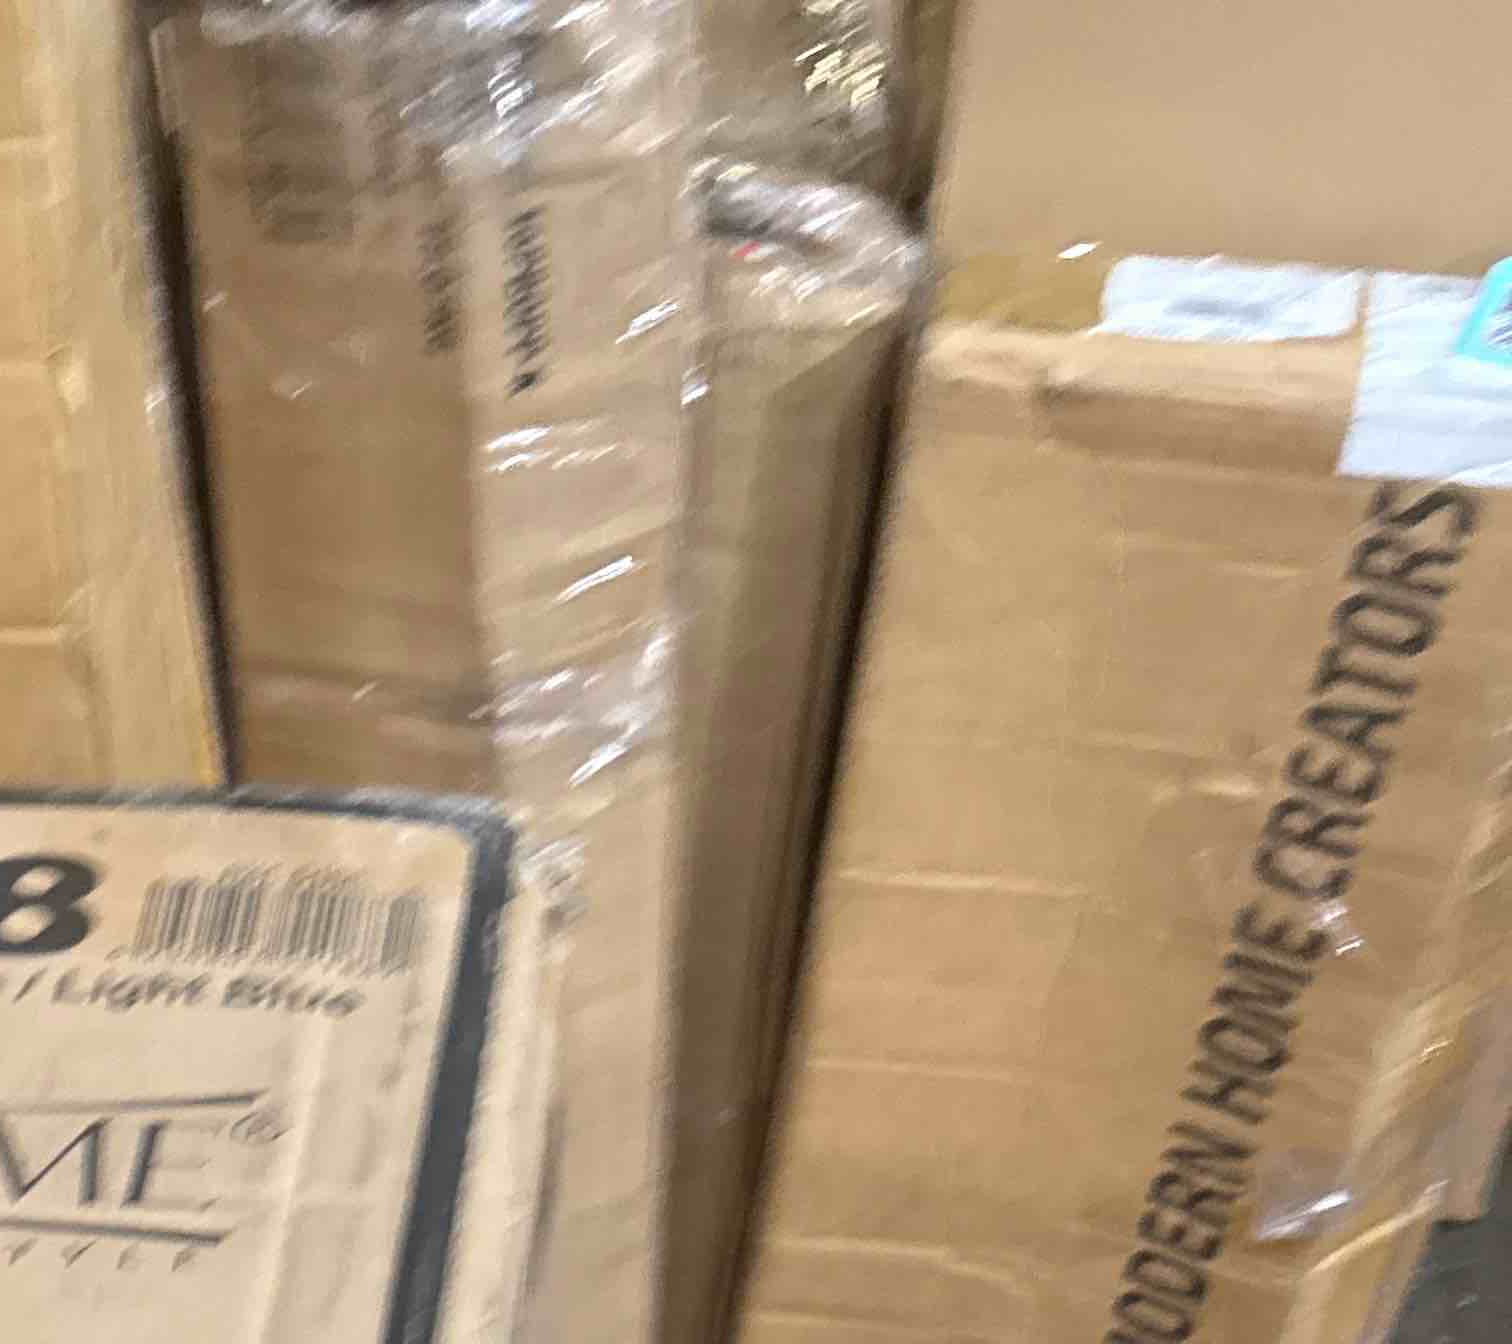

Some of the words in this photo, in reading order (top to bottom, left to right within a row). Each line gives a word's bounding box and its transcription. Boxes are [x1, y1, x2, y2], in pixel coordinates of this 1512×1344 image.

[1254, 482, 1479, 900] CREATORS
[50, 968, 212, 1016] Light
[1183, 900, 1330, 1125] HOME
